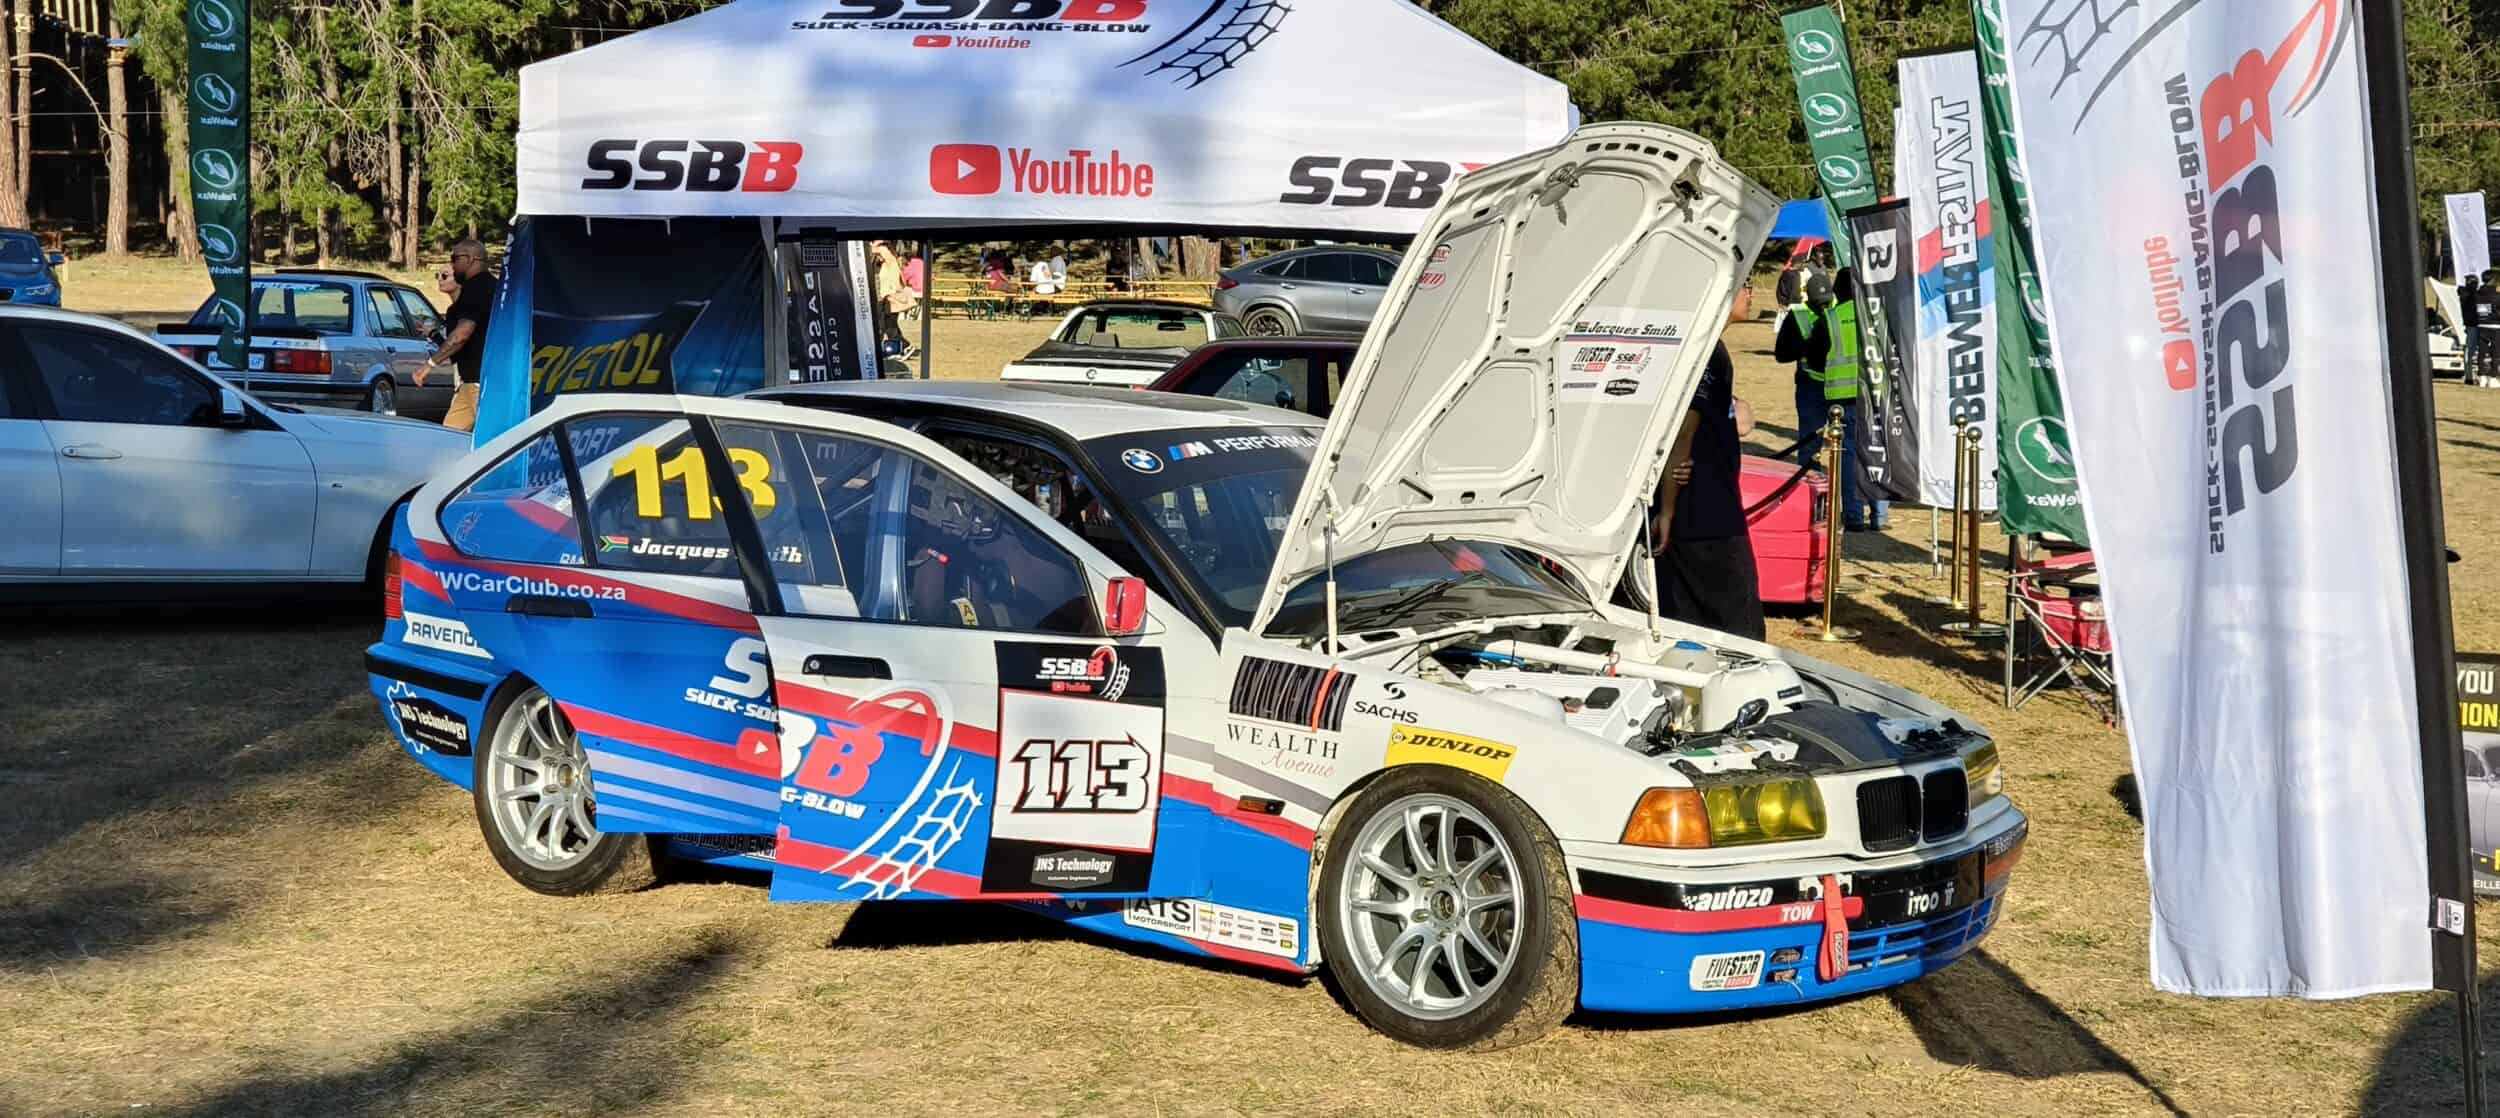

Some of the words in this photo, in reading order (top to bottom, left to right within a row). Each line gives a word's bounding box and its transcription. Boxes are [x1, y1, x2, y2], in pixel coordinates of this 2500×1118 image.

[791, 20, 1152, 34] SUCK-SQUASH-BANG-BLOW
[956, 36, 1031, 50] YouTube
[581, 139, 803, 192] SSBB
[1007, 148, 1154, 198] YouTube
[1279, 156, 1470, 208] SSB
[1588, 321, 1640, 336] Jacques
[1640, 324, 1678, 337] Smith
[530, 332, 664, 396] AVENOL
[612, 443, 777, 521] 113
[632, 537, 731, 560] Jacques
[434, 570, 627, 601] WCarClub.co.za
[410, 620, 480, 648] RAVENO
[1040, 656, 1104, 677] SSBB
[1353, 699, 1419, 725] SACHS
[1226, 723, 1340, 760] WEALTH
[1409, 732, 1513, 762] DUNLOP
[1010, 733, 1151, 815] 113
[1261, 746, 1336, 778] Avenue
[1034, 857, 1055, 872] JNS
[1055, 857, 1113, 874] Technology
[1132, 914, 1192, 932] MOTORSPORT
[1133, 898, 1192, 923] ATS
[1780, 904, 1816, 922] TOW
